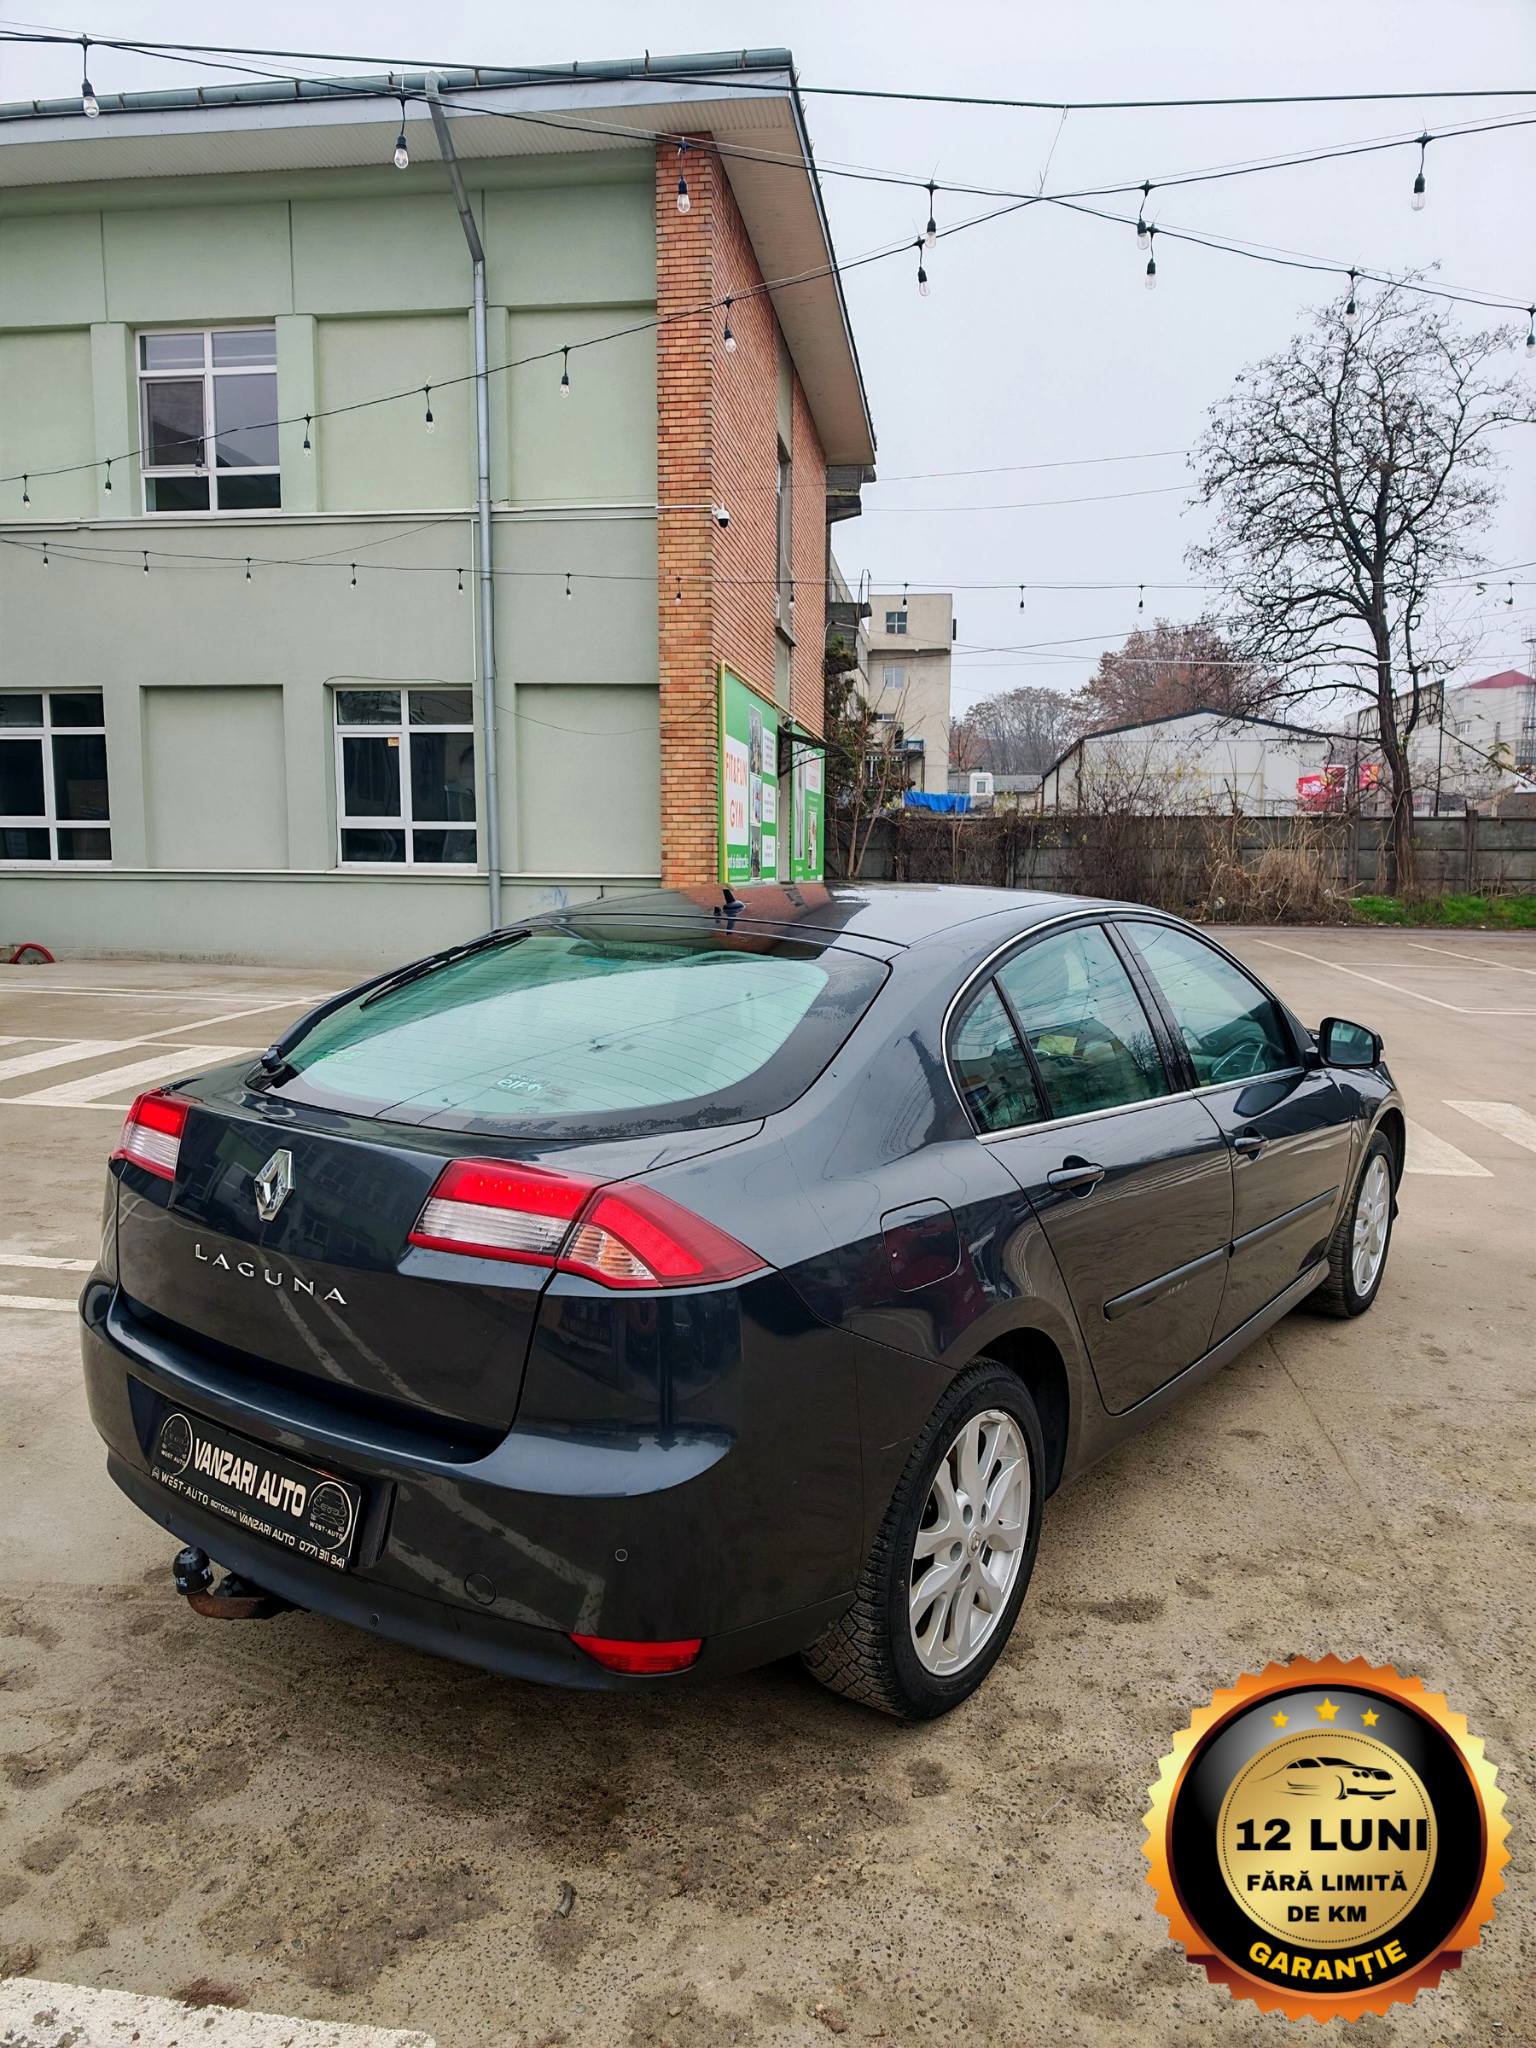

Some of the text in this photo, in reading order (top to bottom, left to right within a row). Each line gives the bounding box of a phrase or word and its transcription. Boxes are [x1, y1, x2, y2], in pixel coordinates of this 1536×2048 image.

[730, 799, 744, 829] GYM
[195, 1243, 347, 1305] LAGUNA
[194, 1437, 307, 1518] VANZARI AUTO
[160, 1471, 345, 1569] WEST-AUTO BOTOSANI VANZARI AUTO 0771 311 941
